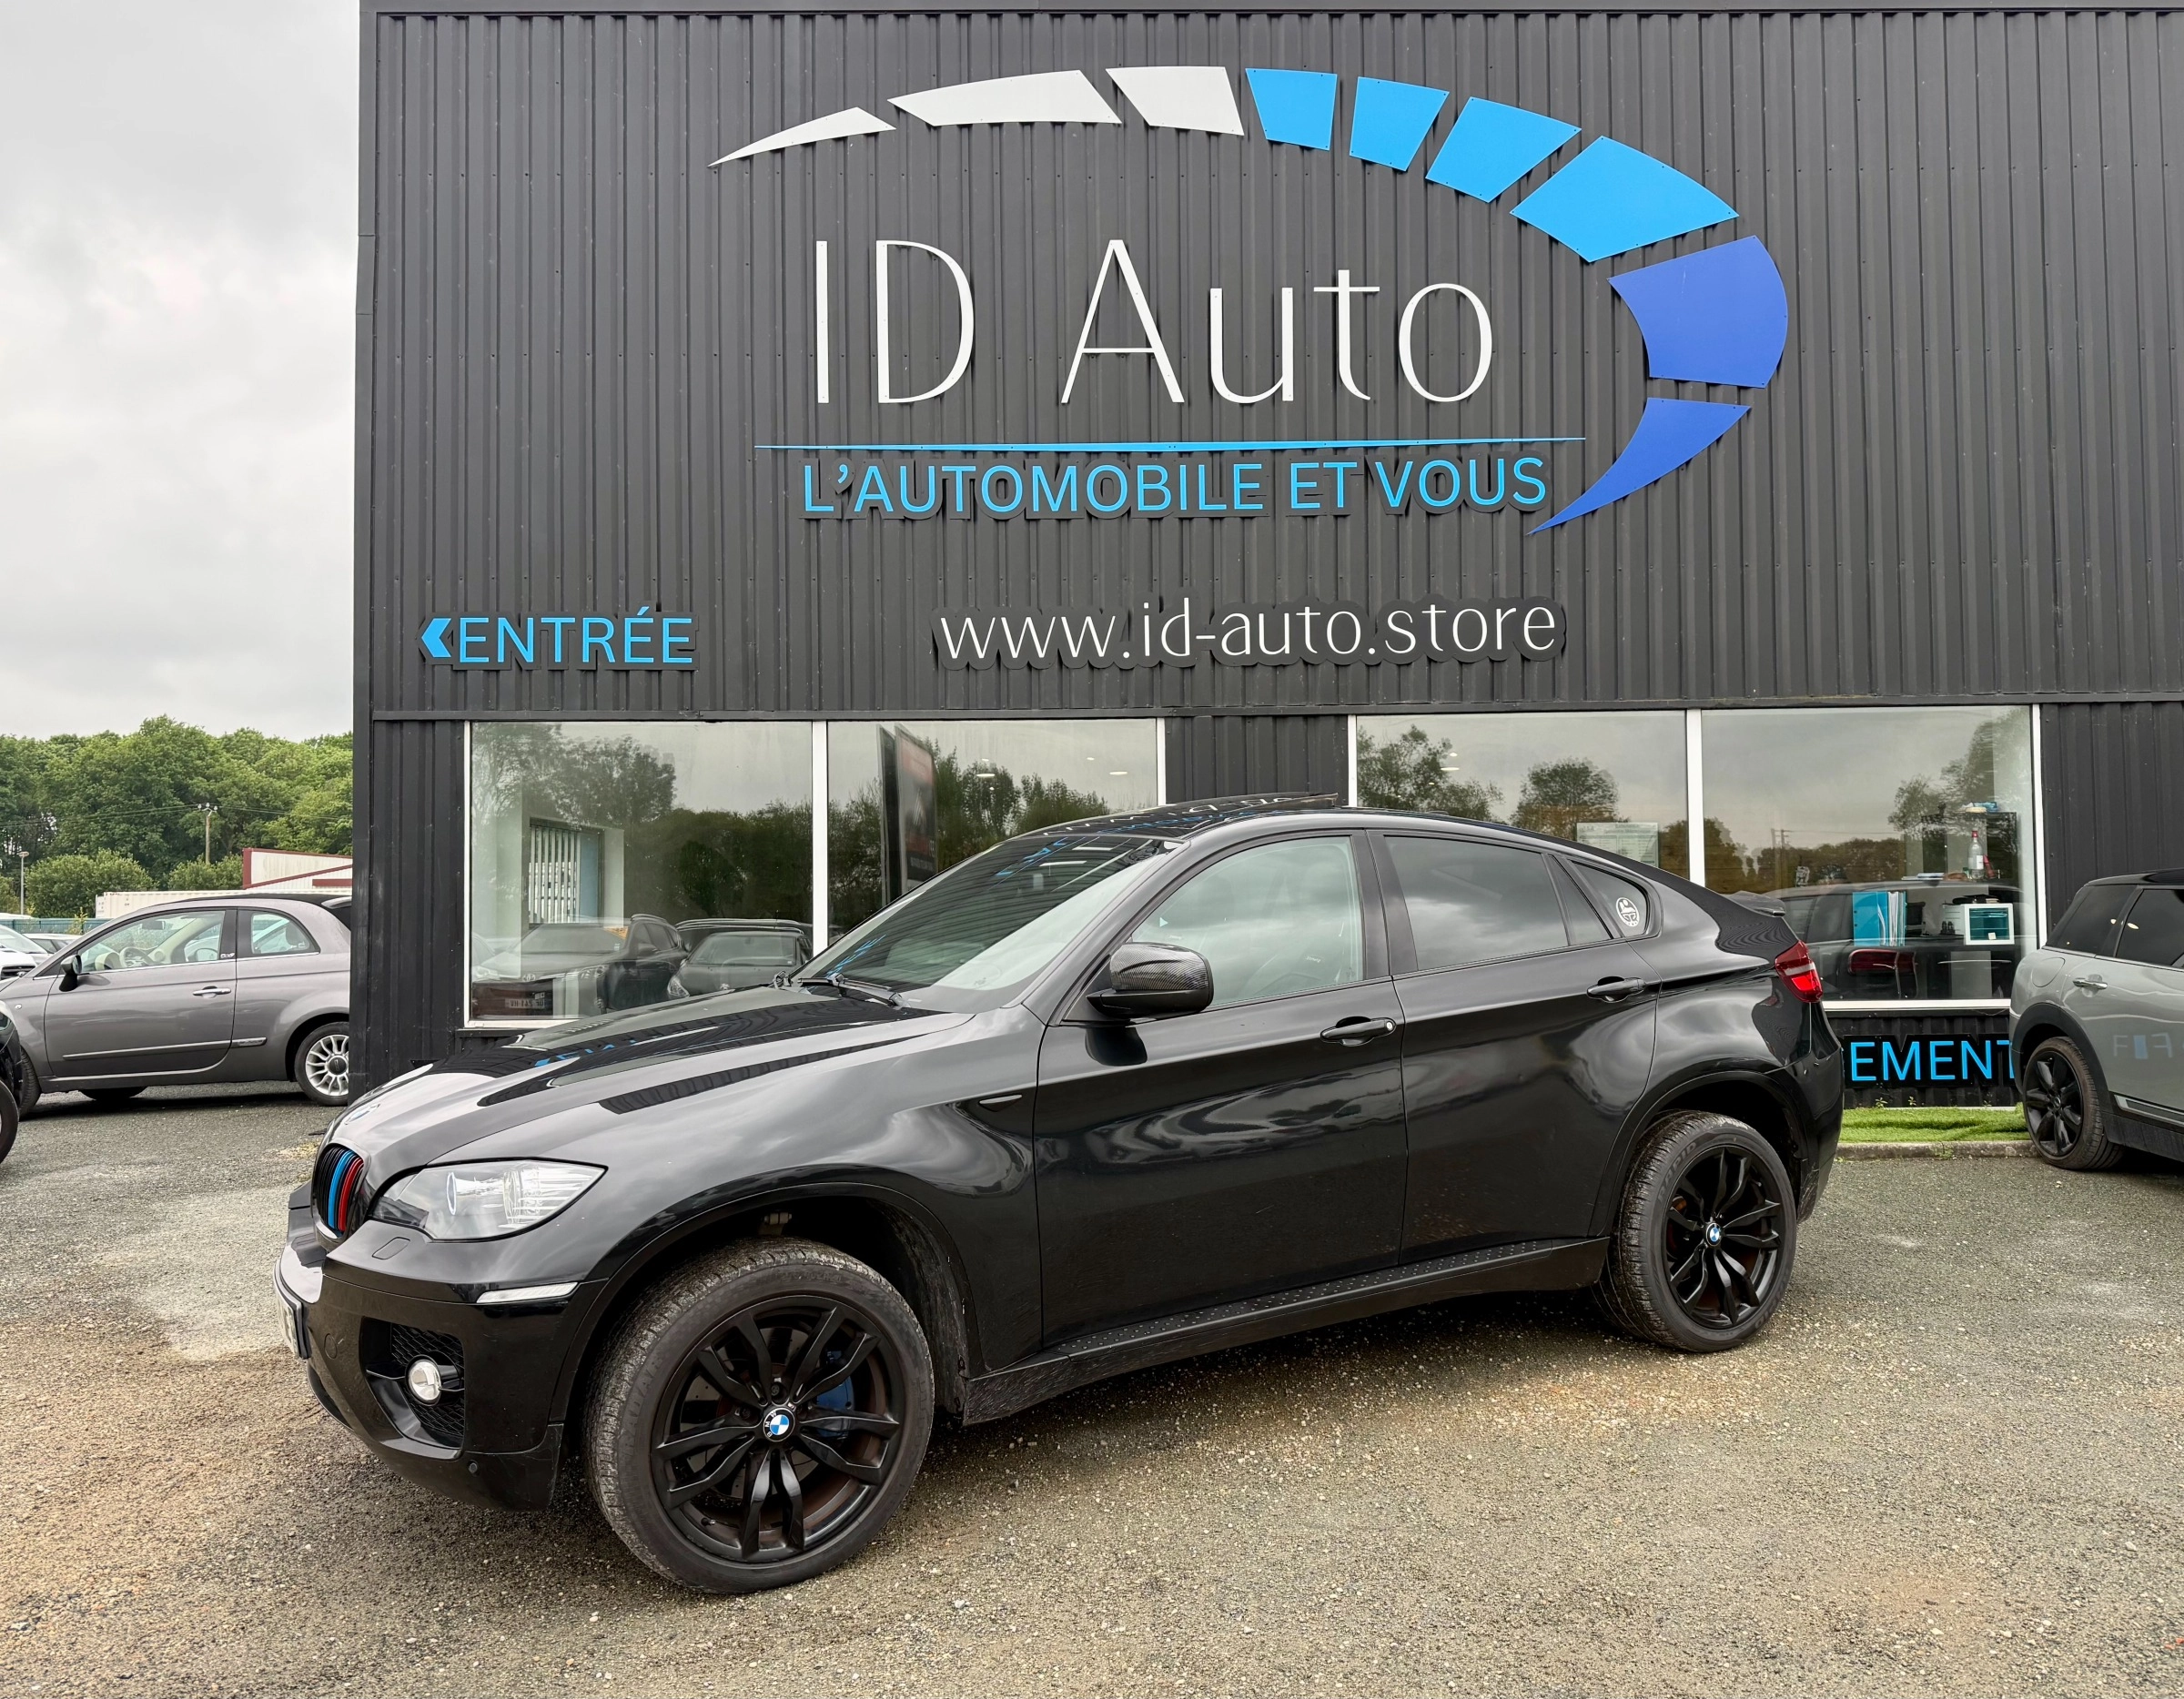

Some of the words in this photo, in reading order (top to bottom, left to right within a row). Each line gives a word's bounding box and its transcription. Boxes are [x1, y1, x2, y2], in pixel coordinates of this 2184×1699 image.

[814, 239, 975, 404] ID
[1060, 239, 1492, 404] Auto
[803, 463, 1262, 515] L'AUTOMOBILE
[1290, 462, 1358, 511] ET
[1374, 456, 1547, 509] VOUS
[459, 606, 693, 664] ENTRÉE
[939, 596, 1556, 660] www.id-auto.store
